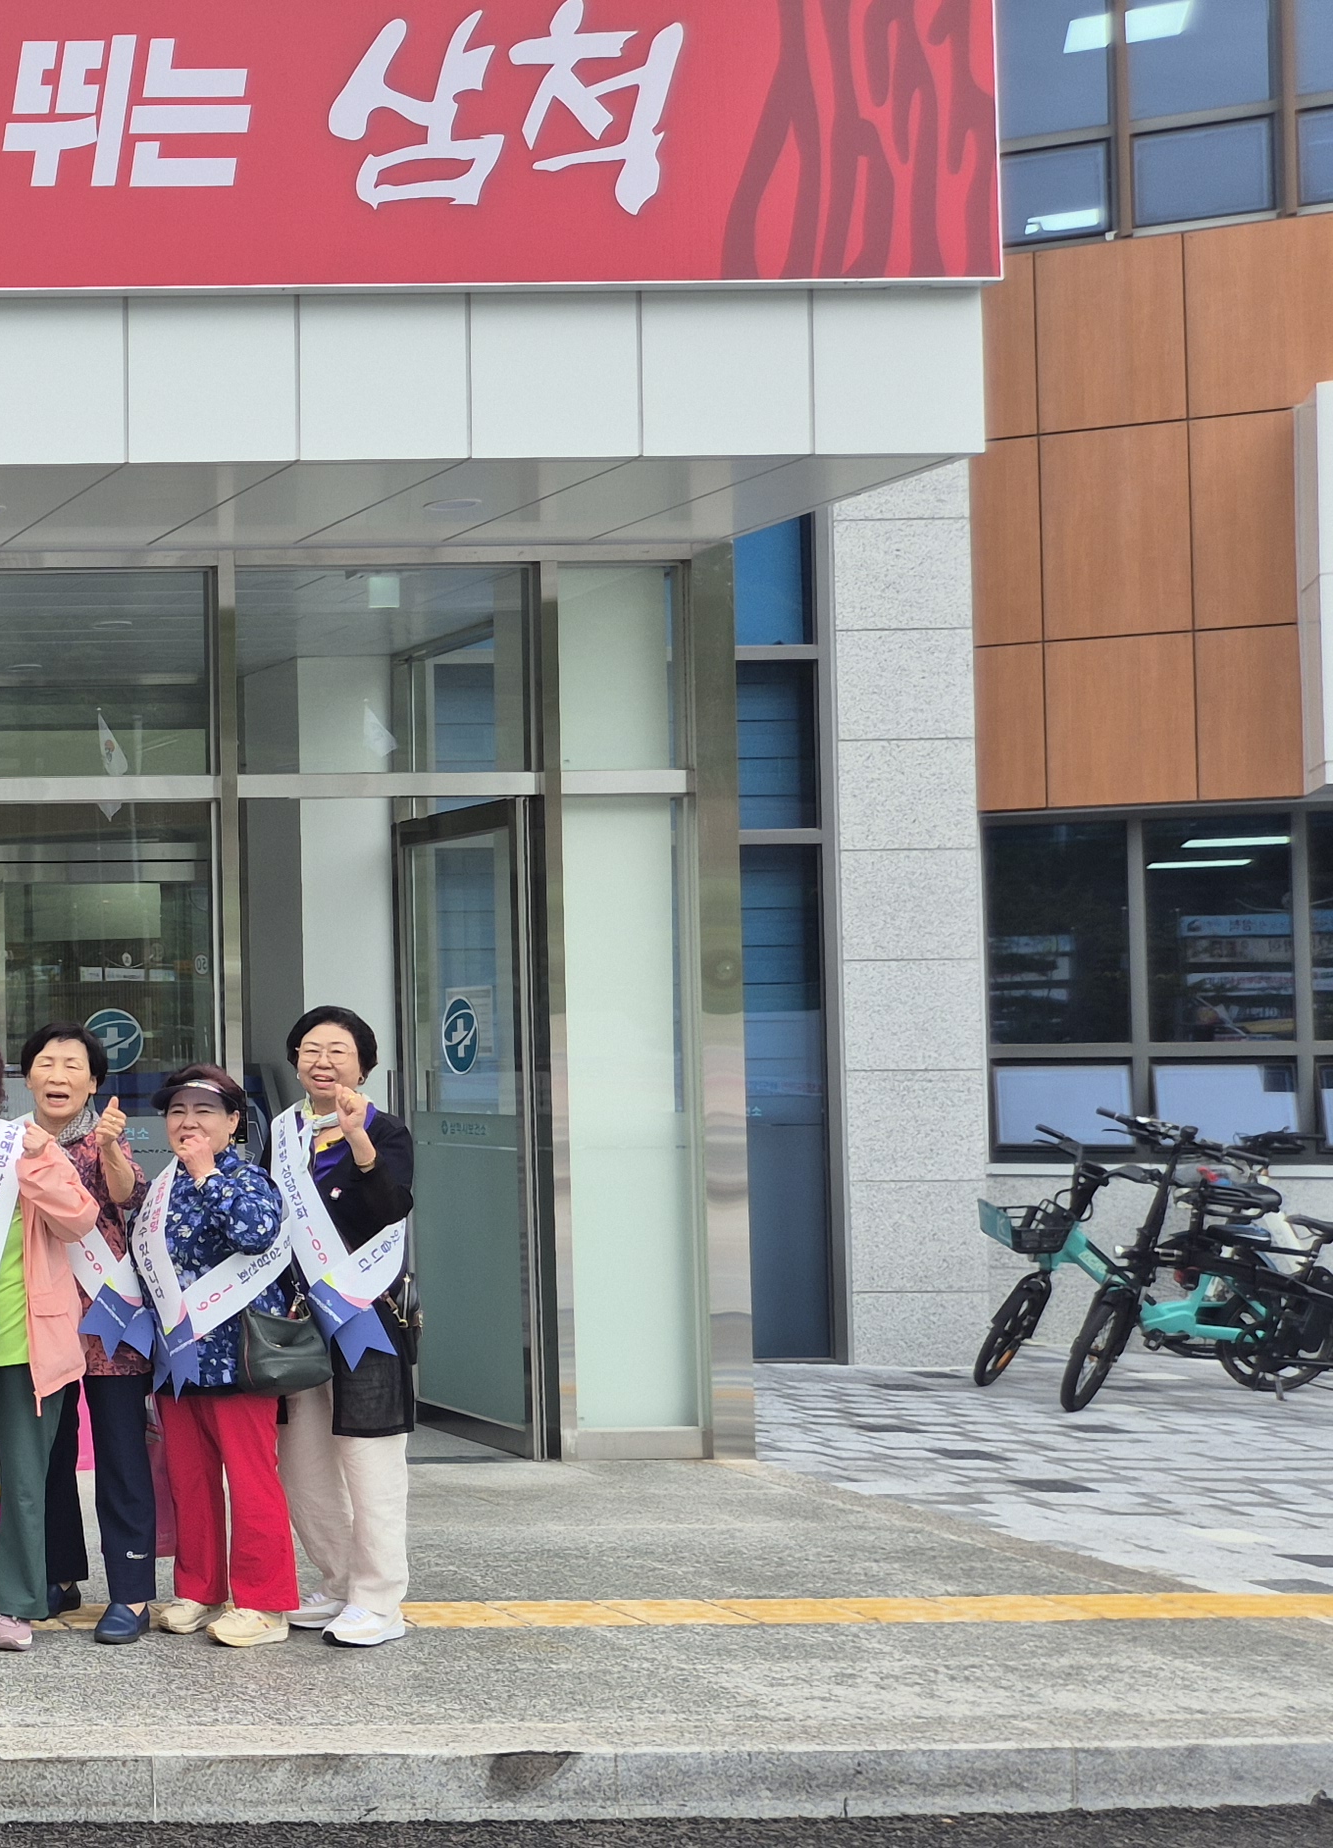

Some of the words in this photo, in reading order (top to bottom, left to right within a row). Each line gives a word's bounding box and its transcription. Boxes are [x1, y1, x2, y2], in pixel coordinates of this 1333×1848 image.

[2, 34, 252, 188] 뛰는
[328, 0, 684, 215] 삼척
[281, 1164, 309, 1220] 상담전화
[305, 1225, 328, 1266] 109
[79, 1240, 103, 1275] 109
[236, 1247, 282, 1285] 상담전화
[196, 1283, 234, 1311] 109
